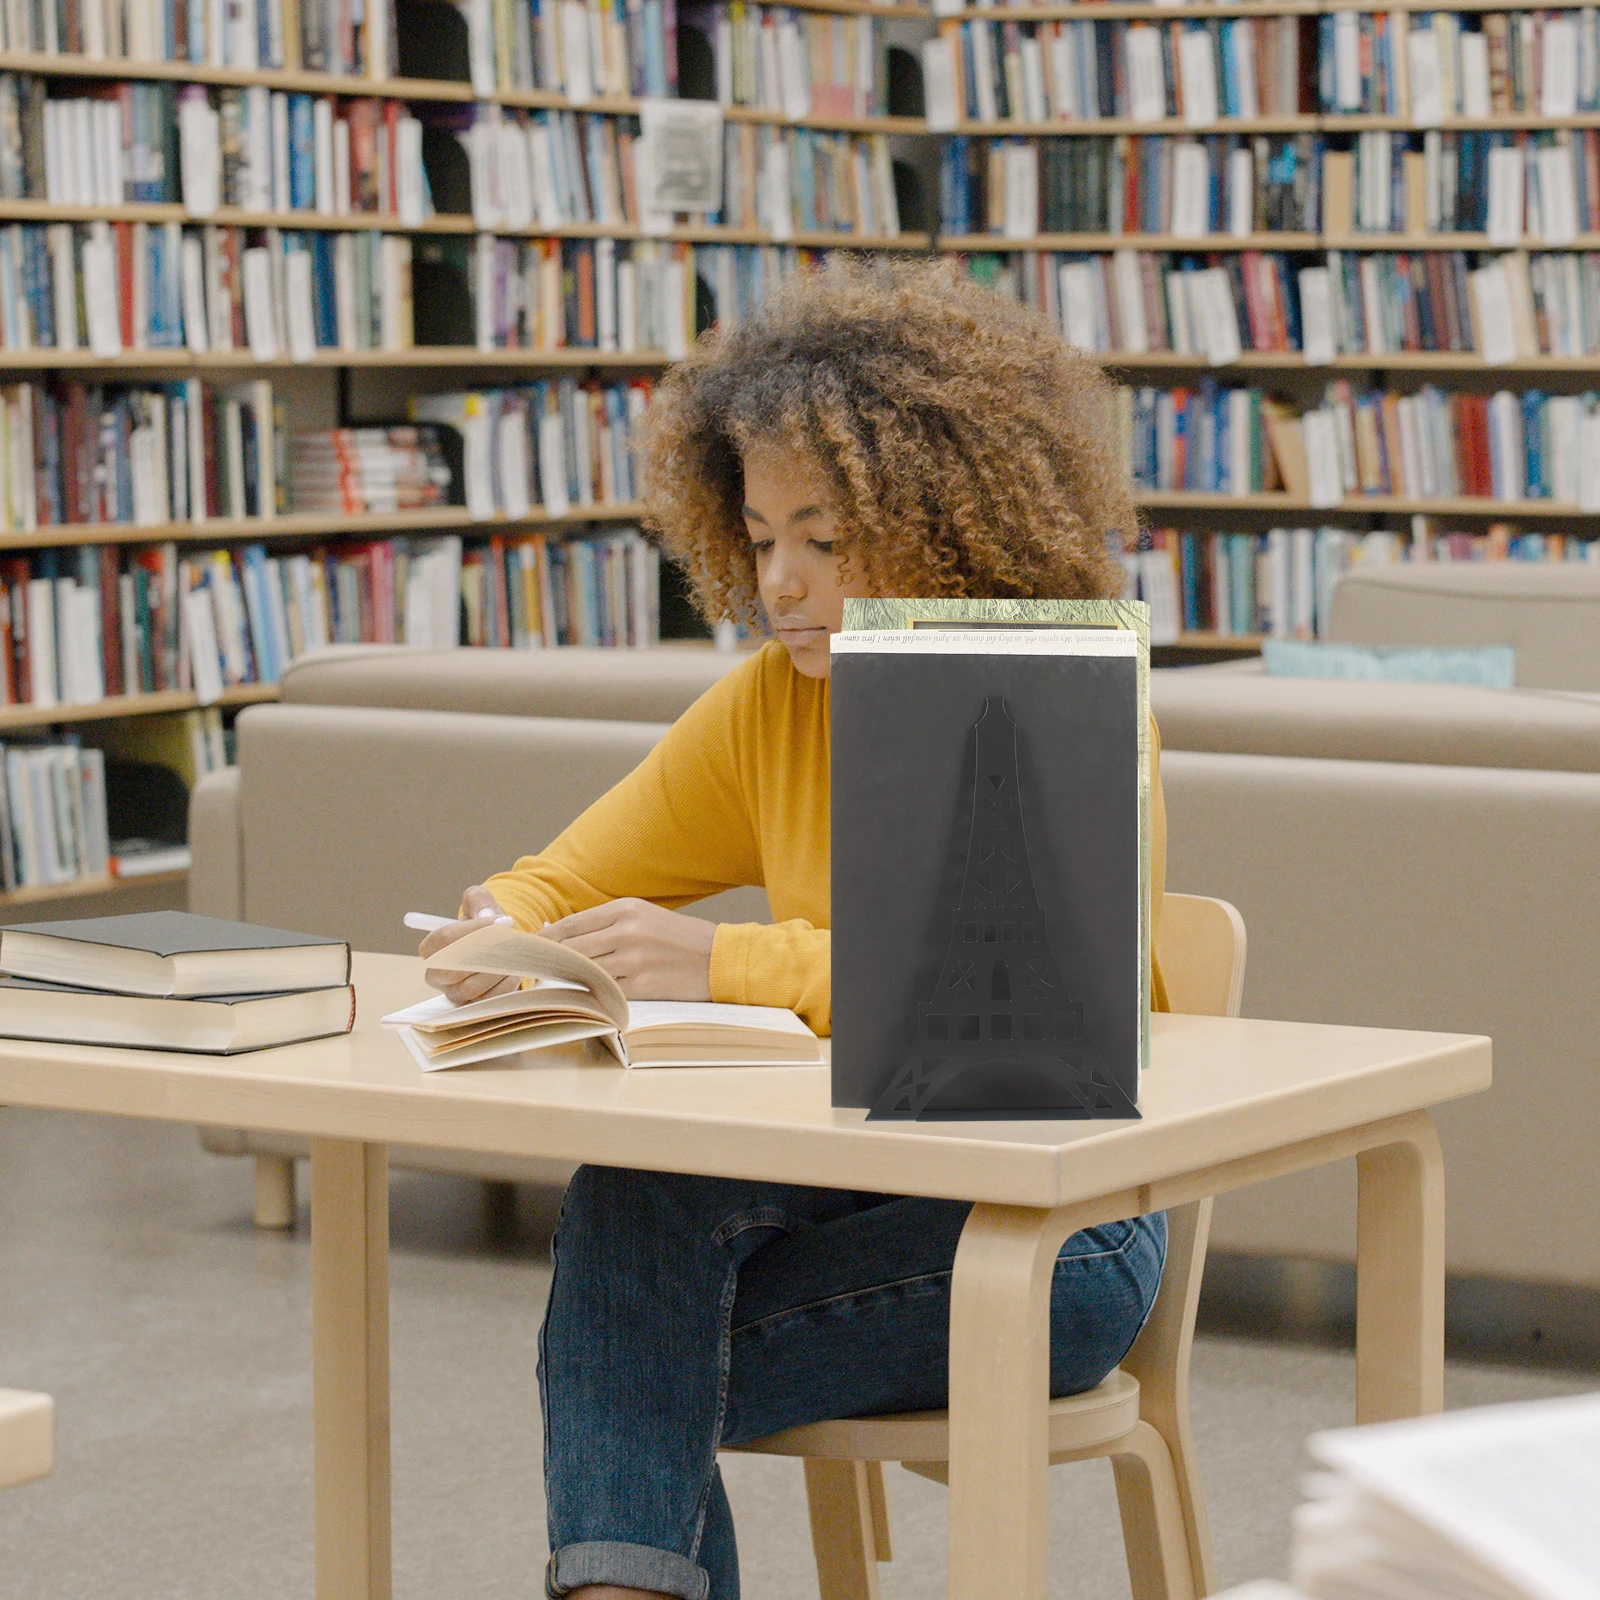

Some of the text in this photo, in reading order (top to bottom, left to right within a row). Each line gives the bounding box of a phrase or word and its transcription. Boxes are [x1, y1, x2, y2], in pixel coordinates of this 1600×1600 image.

[861, 634, 877, 644] first
[883, 636, 900, 644] when
[900, 634, 932, 644] snowfall
[932, 634, 952, 644] April
[962, 634, 985, 644] during
[985, 636, 997, 644] did
[998, 634, 1013, 644] they
[1038, 634, 1059, 644] spirits
[1060, 634, 1072, 644] My
[1116, 636, 1126, 644] the
